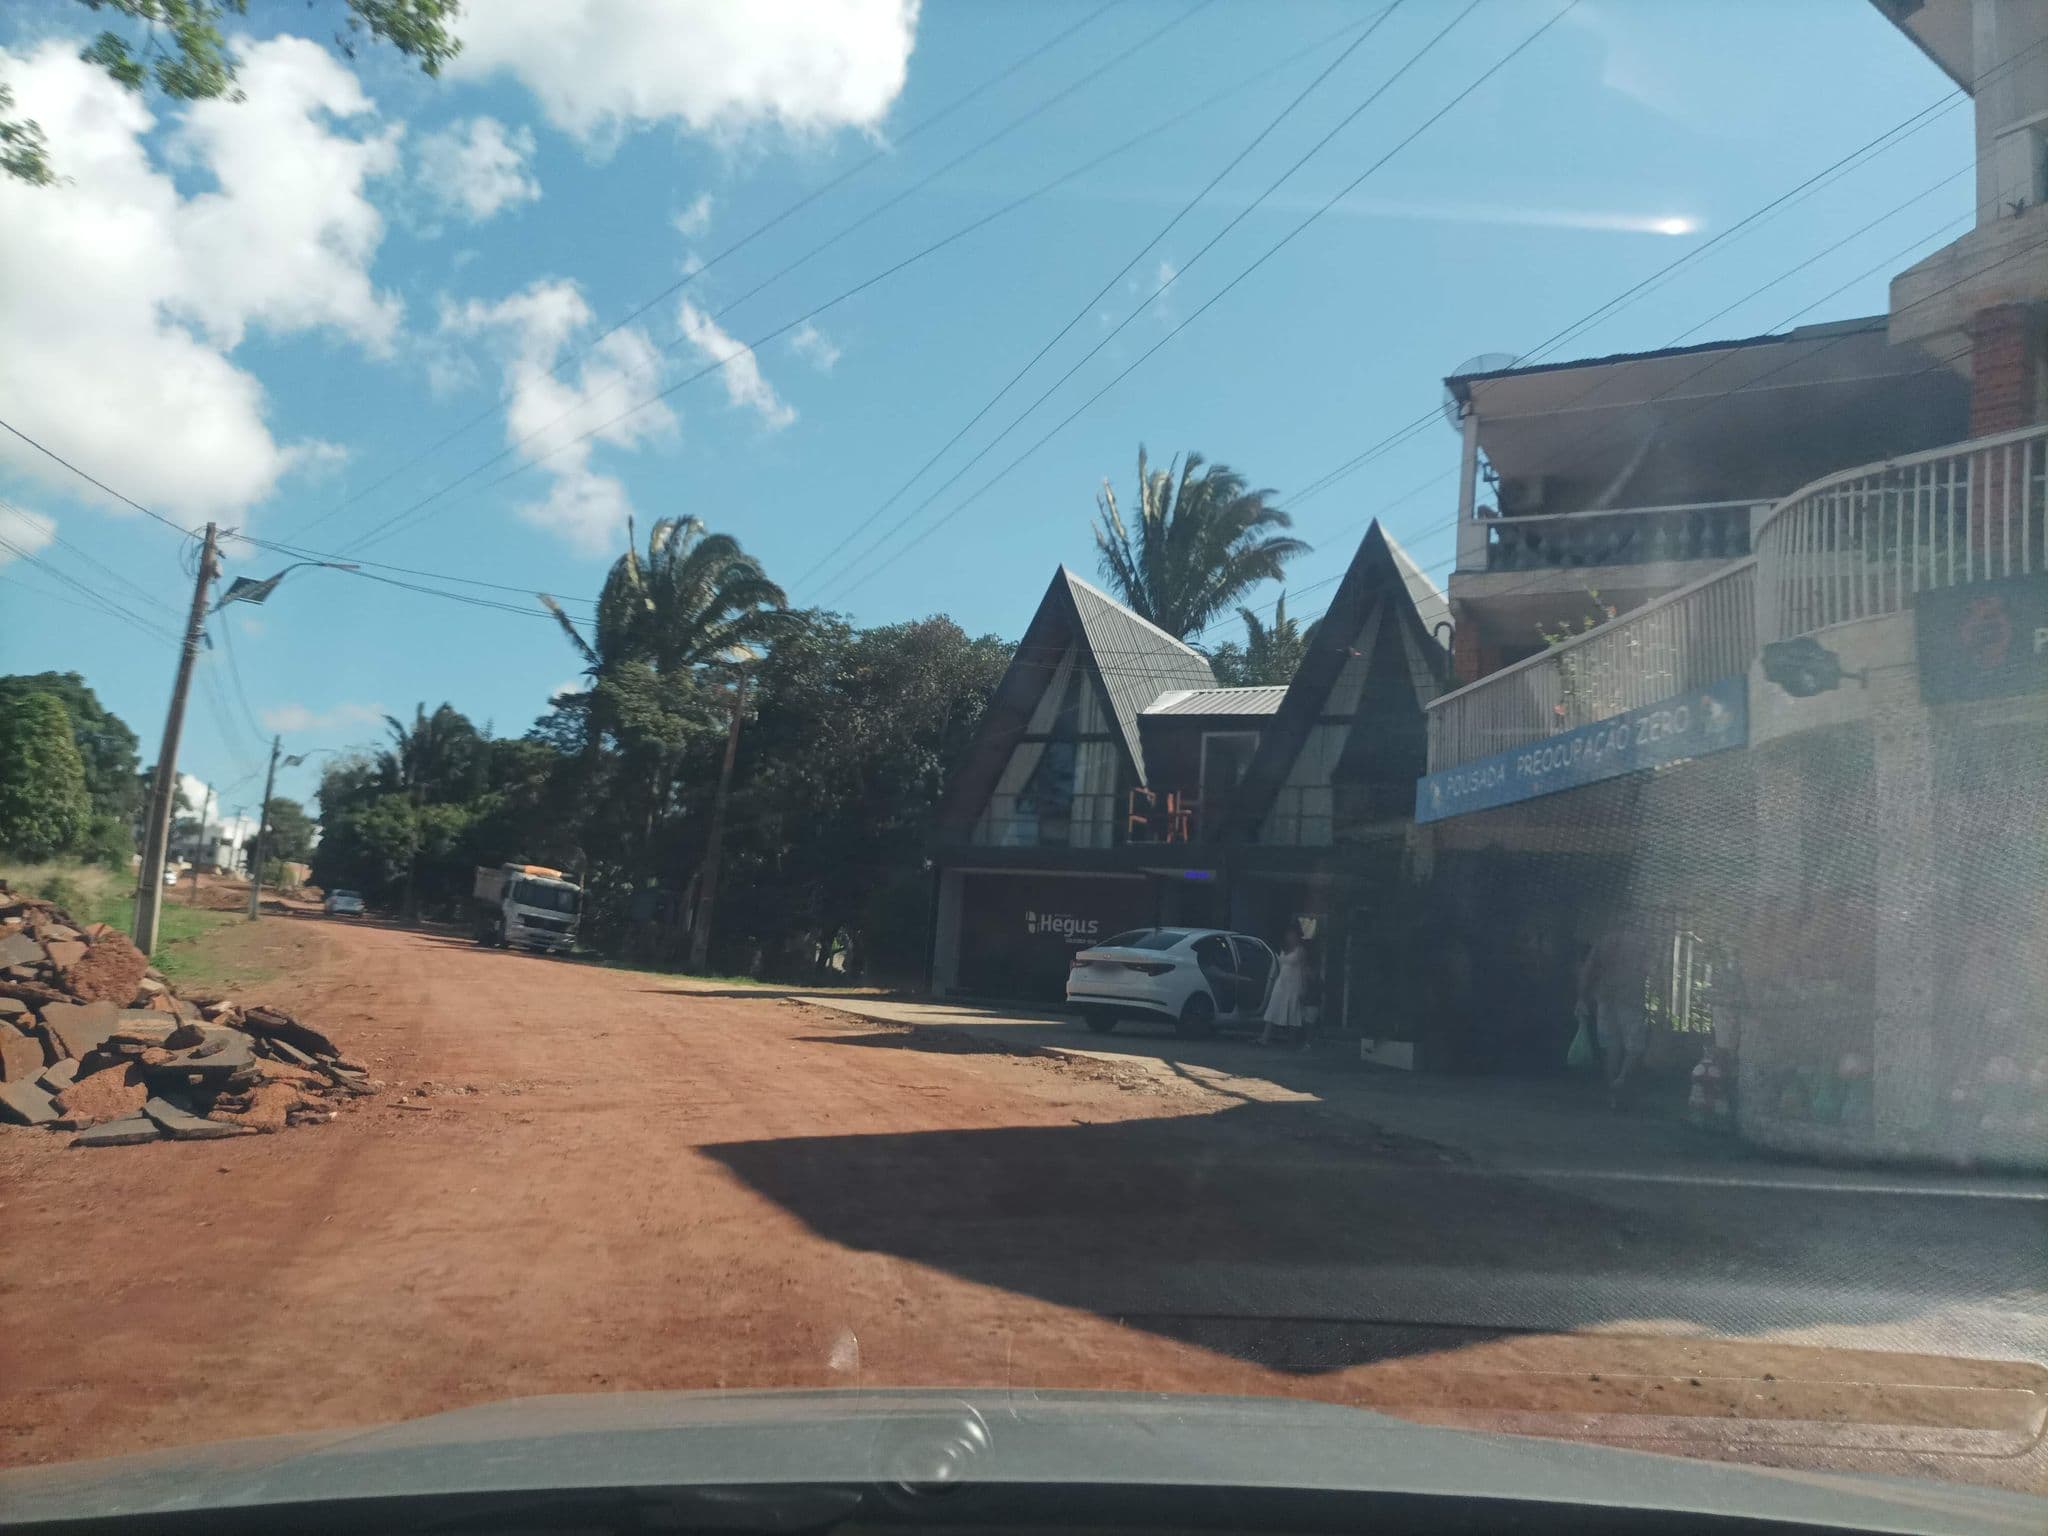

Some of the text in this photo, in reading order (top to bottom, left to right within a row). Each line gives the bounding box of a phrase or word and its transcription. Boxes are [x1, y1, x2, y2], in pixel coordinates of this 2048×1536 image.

[1447, 706, 1689, 797] POUSADA PREOCUPAÇÃO ZERO
[1041, 914, 1099, 937] Hegus
